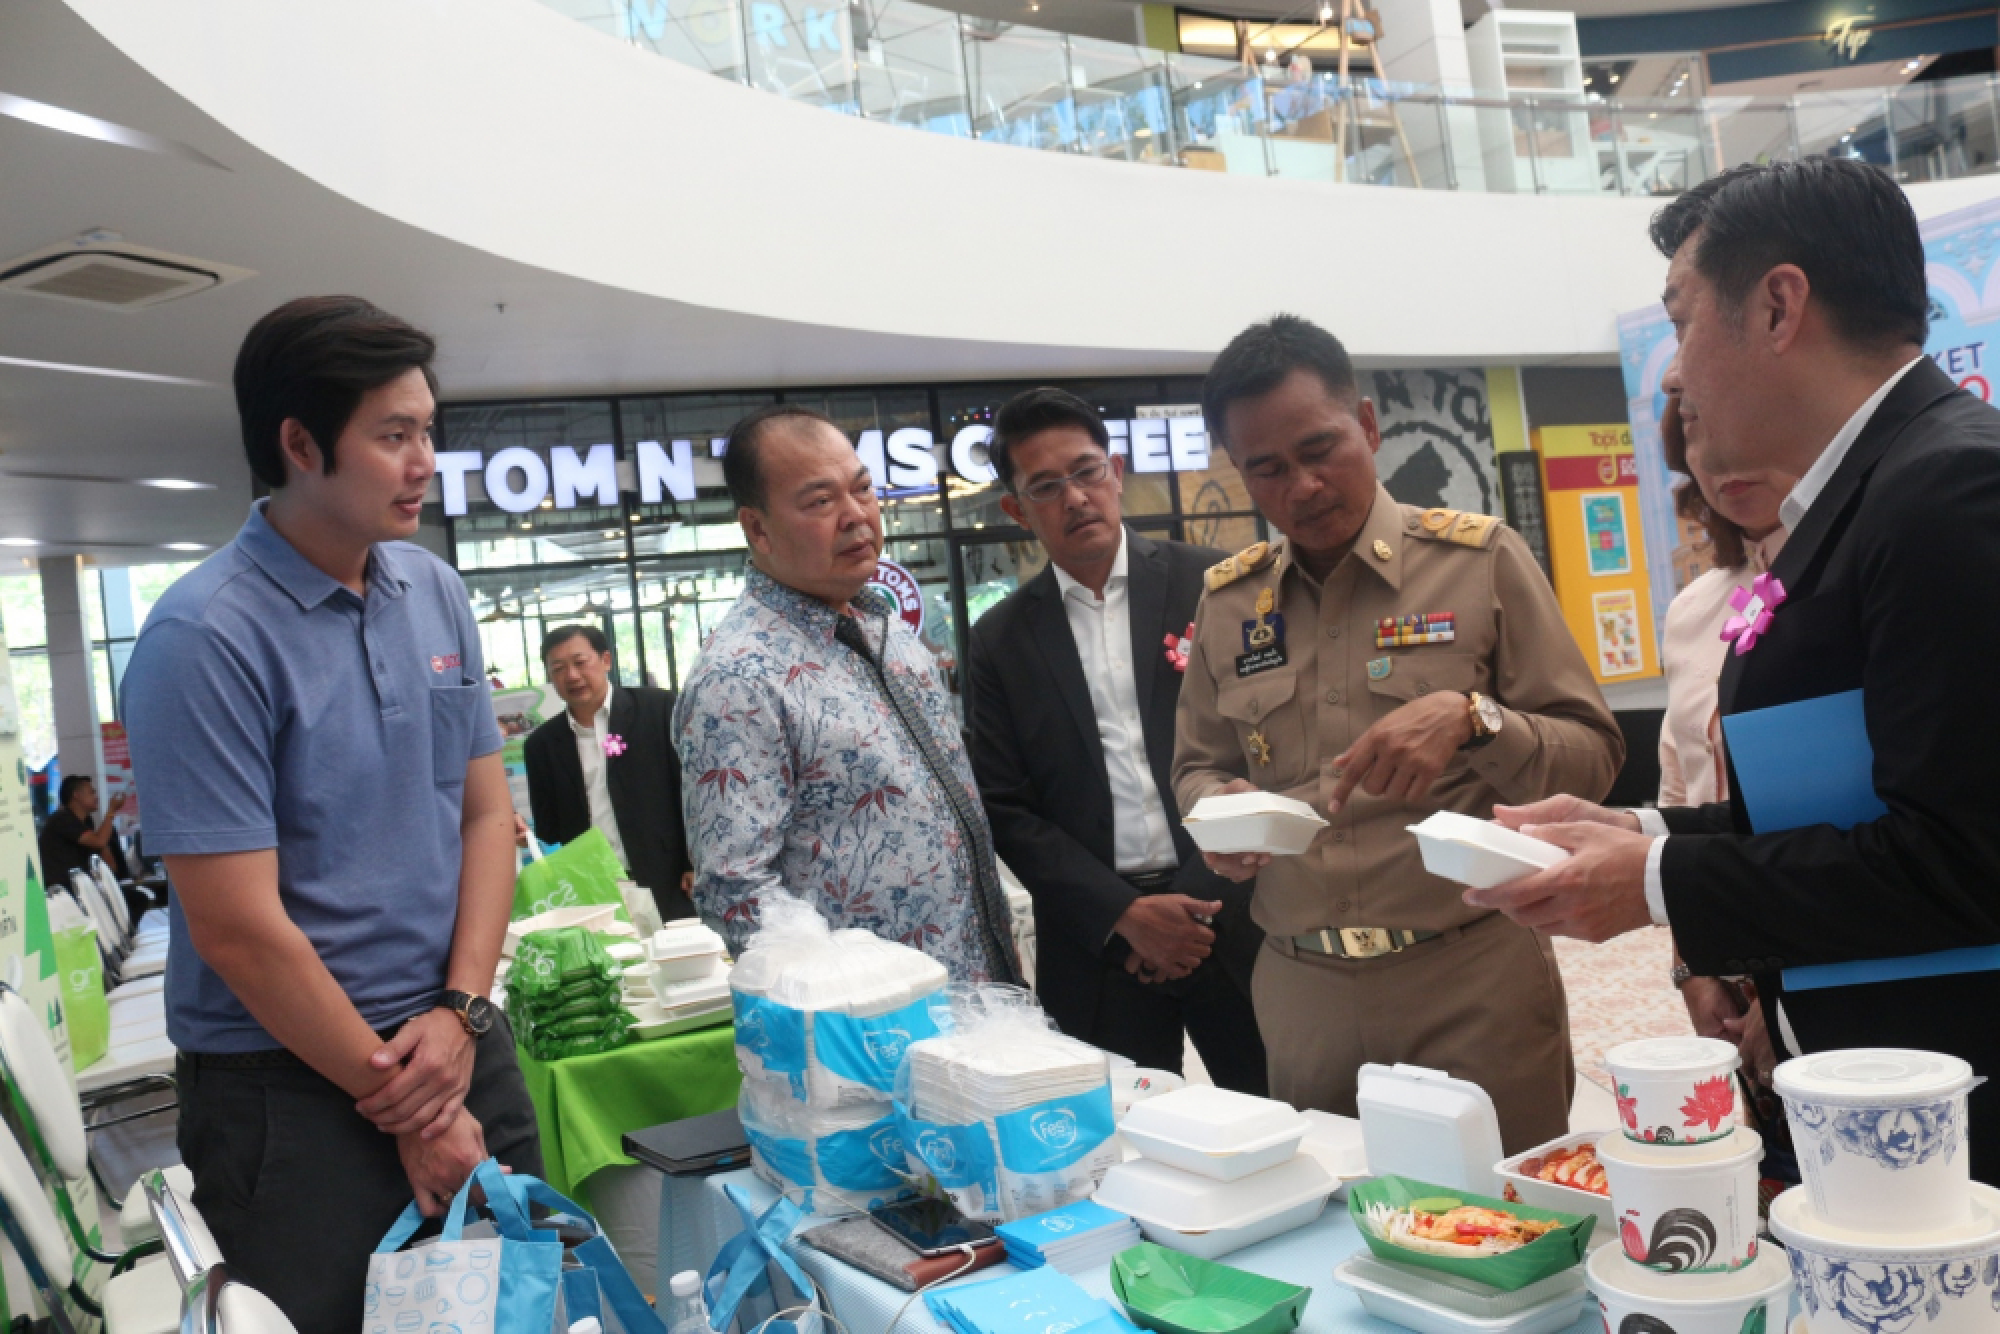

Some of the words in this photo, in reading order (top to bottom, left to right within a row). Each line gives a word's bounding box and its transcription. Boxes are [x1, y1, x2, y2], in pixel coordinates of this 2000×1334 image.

[1424, 367, 1494, 445] TO
[433, 445, 619, 517] TOM
[636, 439, 697, 503] N
[951, 416, 1210, 484] CFEE
